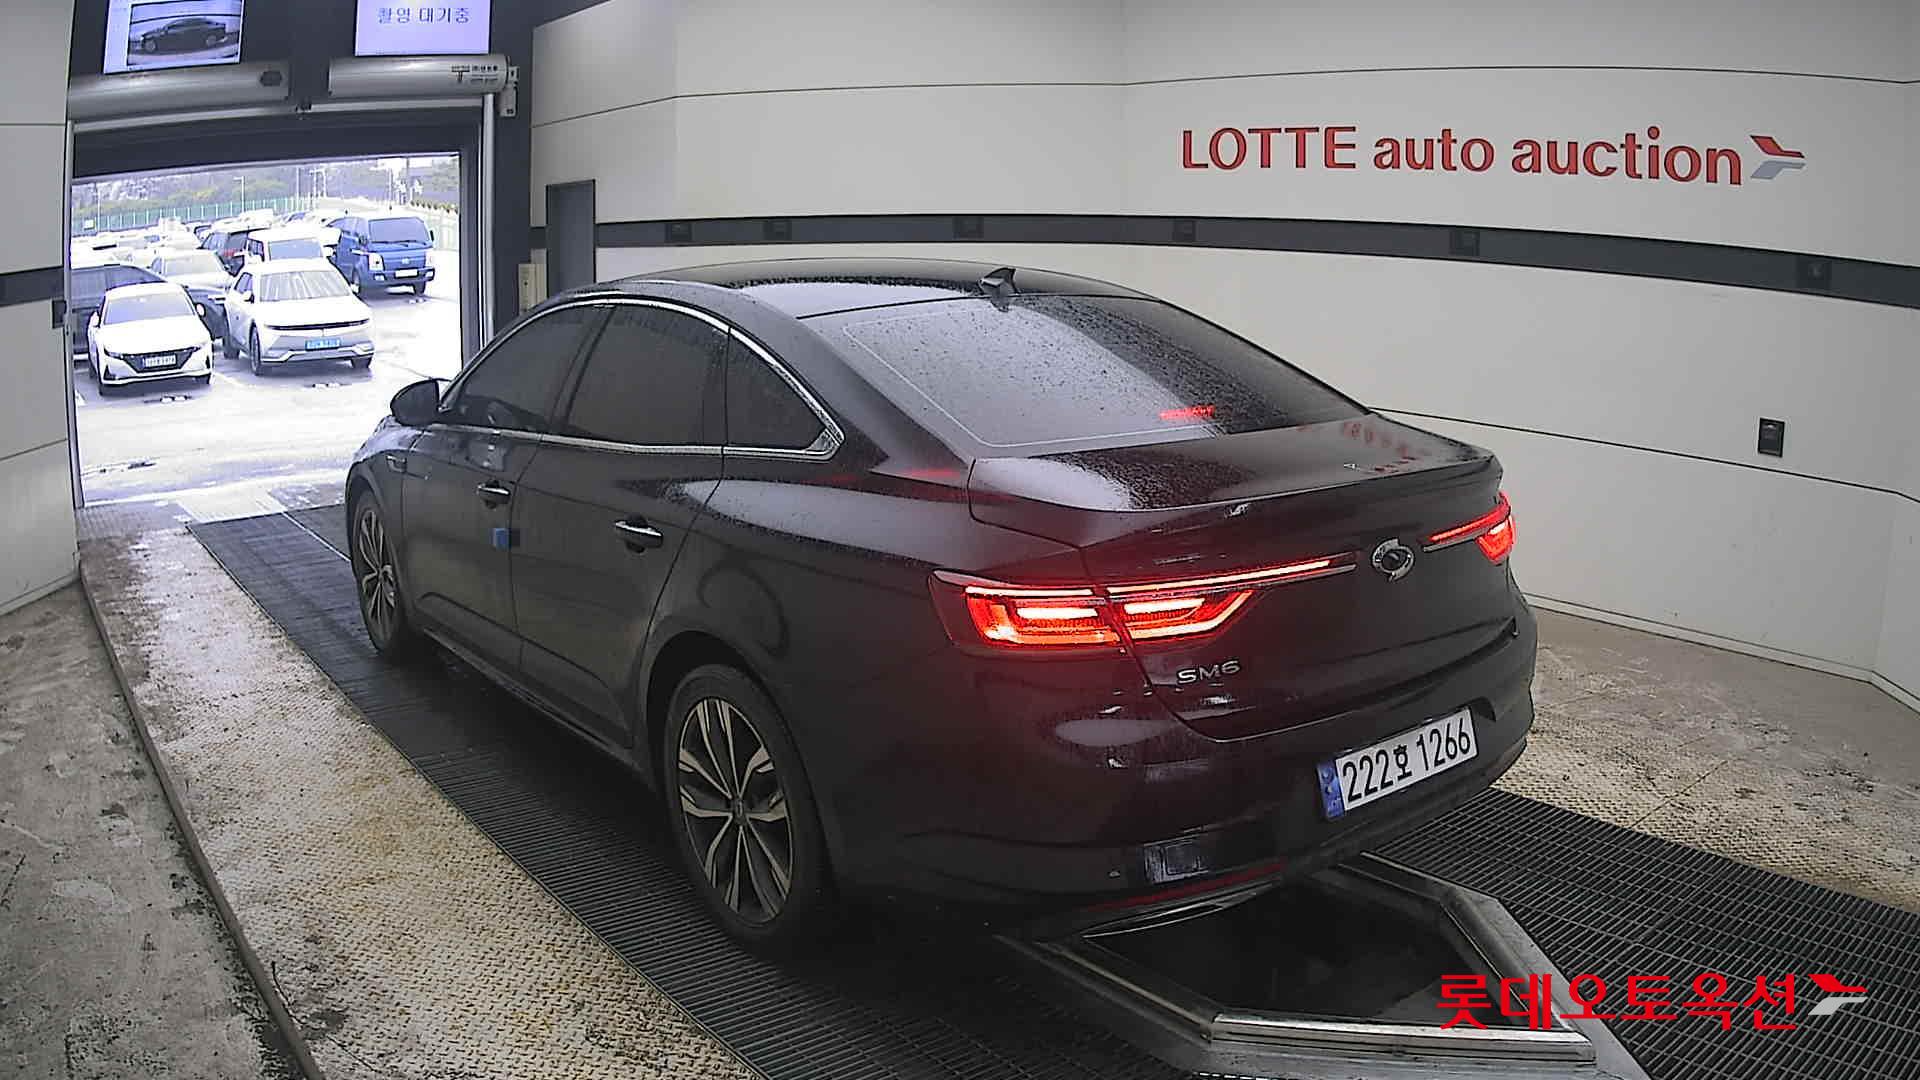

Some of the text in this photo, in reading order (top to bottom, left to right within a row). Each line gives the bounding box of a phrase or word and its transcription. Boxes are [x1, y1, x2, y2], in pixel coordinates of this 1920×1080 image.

[419, 7, 470, 24] 대기중
[1182, 126, 1742, 185] LOTTE auto auction
[1178, 660, 1241, 684] SM6
[1342, 717, 1471, 803] 222호 1266
